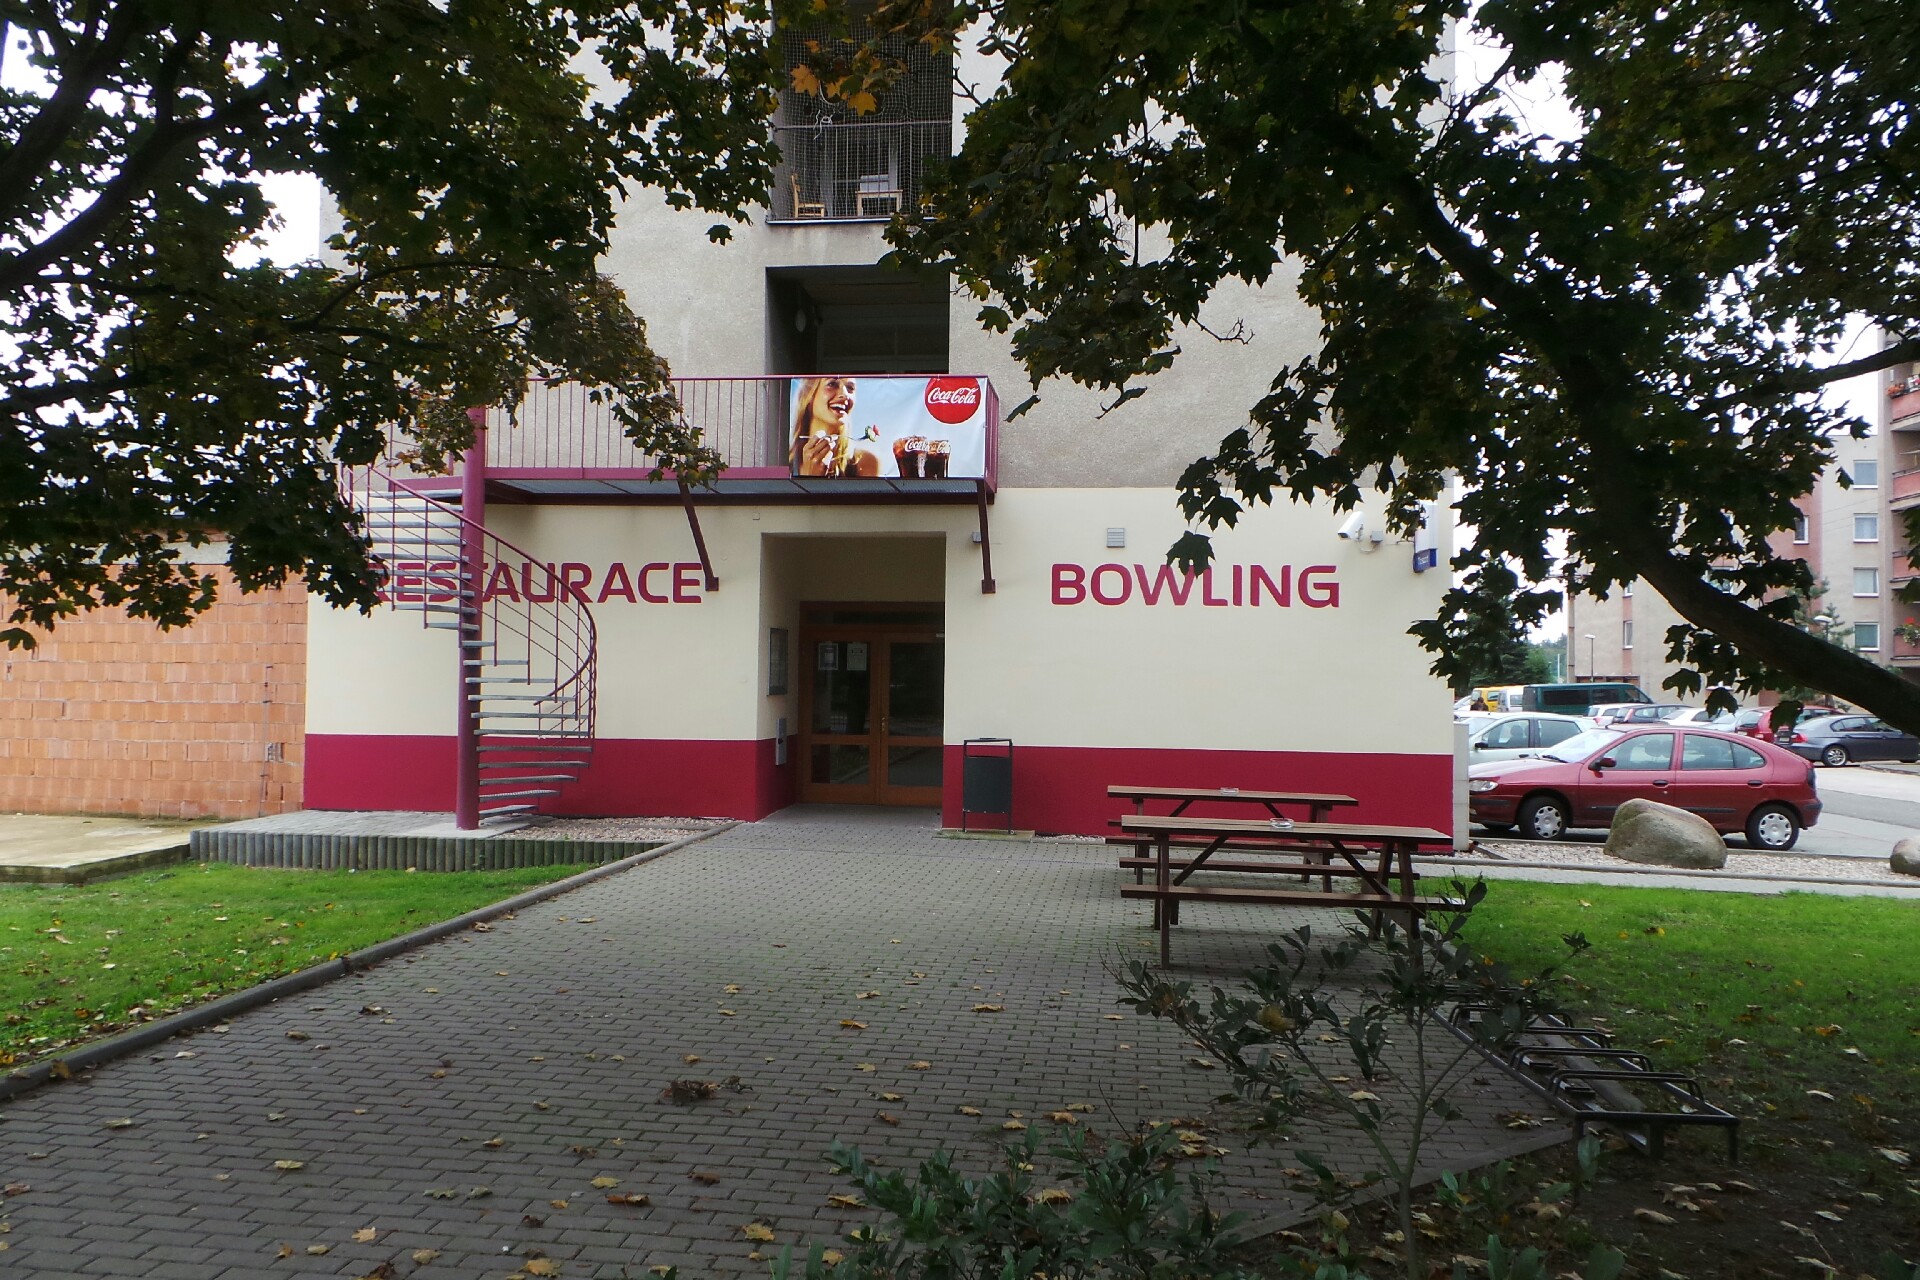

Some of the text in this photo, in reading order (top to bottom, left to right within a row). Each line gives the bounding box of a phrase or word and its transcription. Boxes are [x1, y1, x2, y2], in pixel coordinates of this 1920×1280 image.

[928, 387, 979, 404] Coca-Cola
[364, 562, 703, 603] ESAURACE
[1051, 563, 1340, 608] BOWLING
